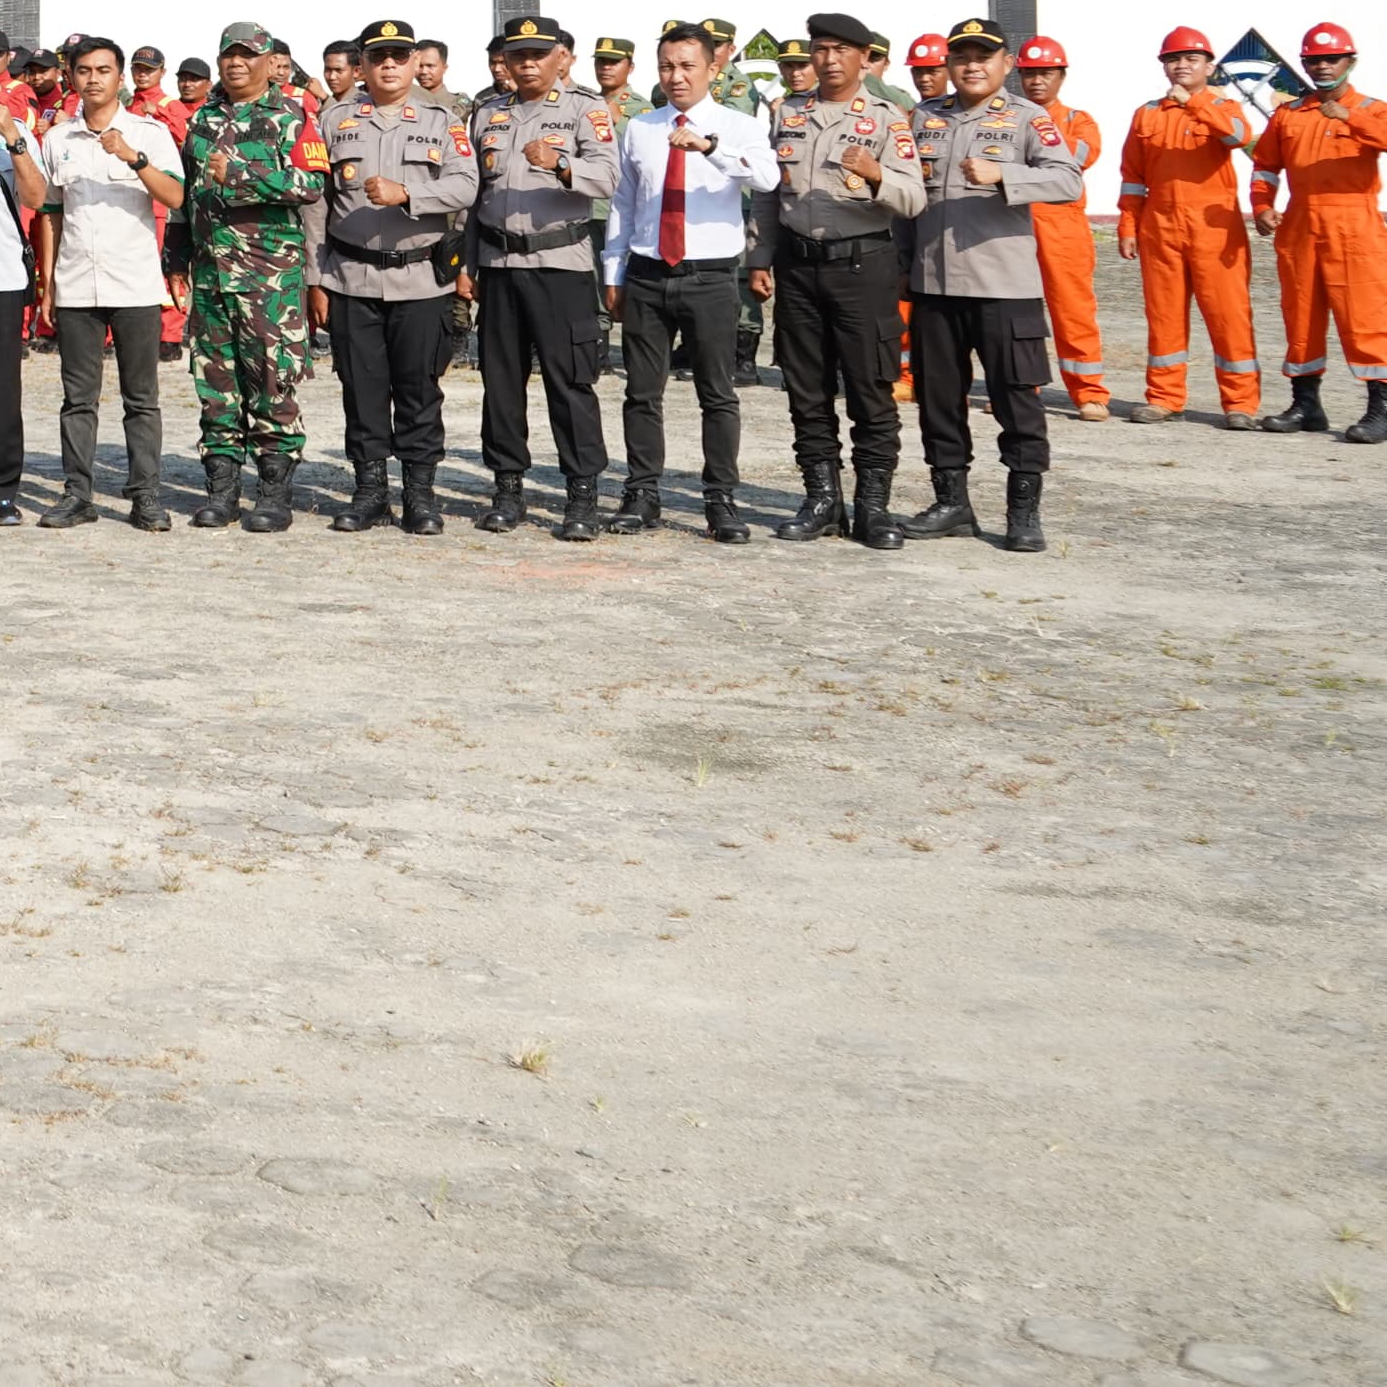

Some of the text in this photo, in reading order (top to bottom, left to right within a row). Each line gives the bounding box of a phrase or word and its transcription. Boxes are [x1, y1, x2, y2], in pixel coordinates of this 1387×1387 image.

[541, 122, 575, 131] POLRI
[407, 135, 443, 146] POLRI
[839, 134, 877, 149] POLRI
[976, 132, 1013, 141] POLRI
